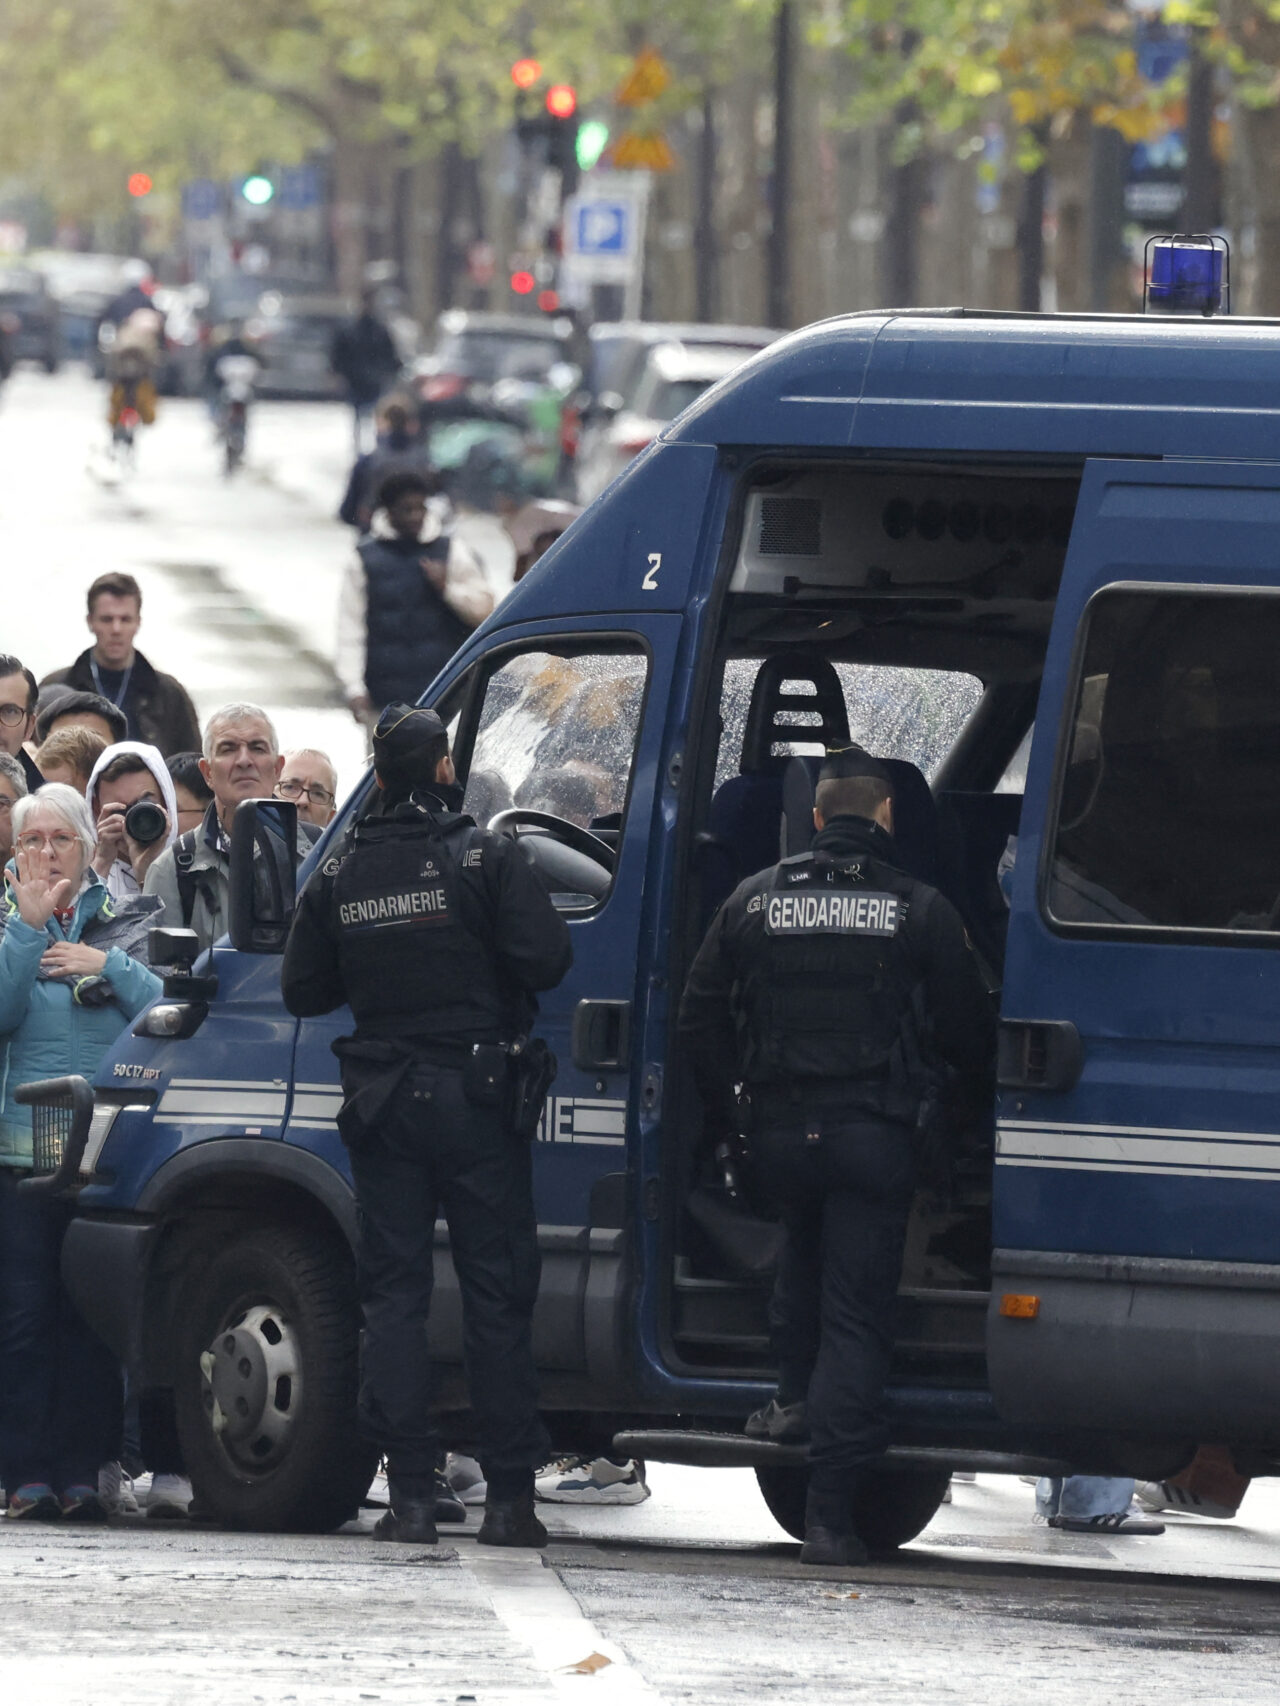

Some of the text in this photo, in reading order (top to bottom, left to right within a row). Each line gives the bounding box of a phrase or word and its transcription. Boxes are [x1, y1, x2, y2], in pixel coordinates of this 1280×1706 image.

[642, 553, 662, 589] 2
[339, 889, 447, 925] GENDARMERIE
[768, 897, 898, 931] GENDARMERIE
